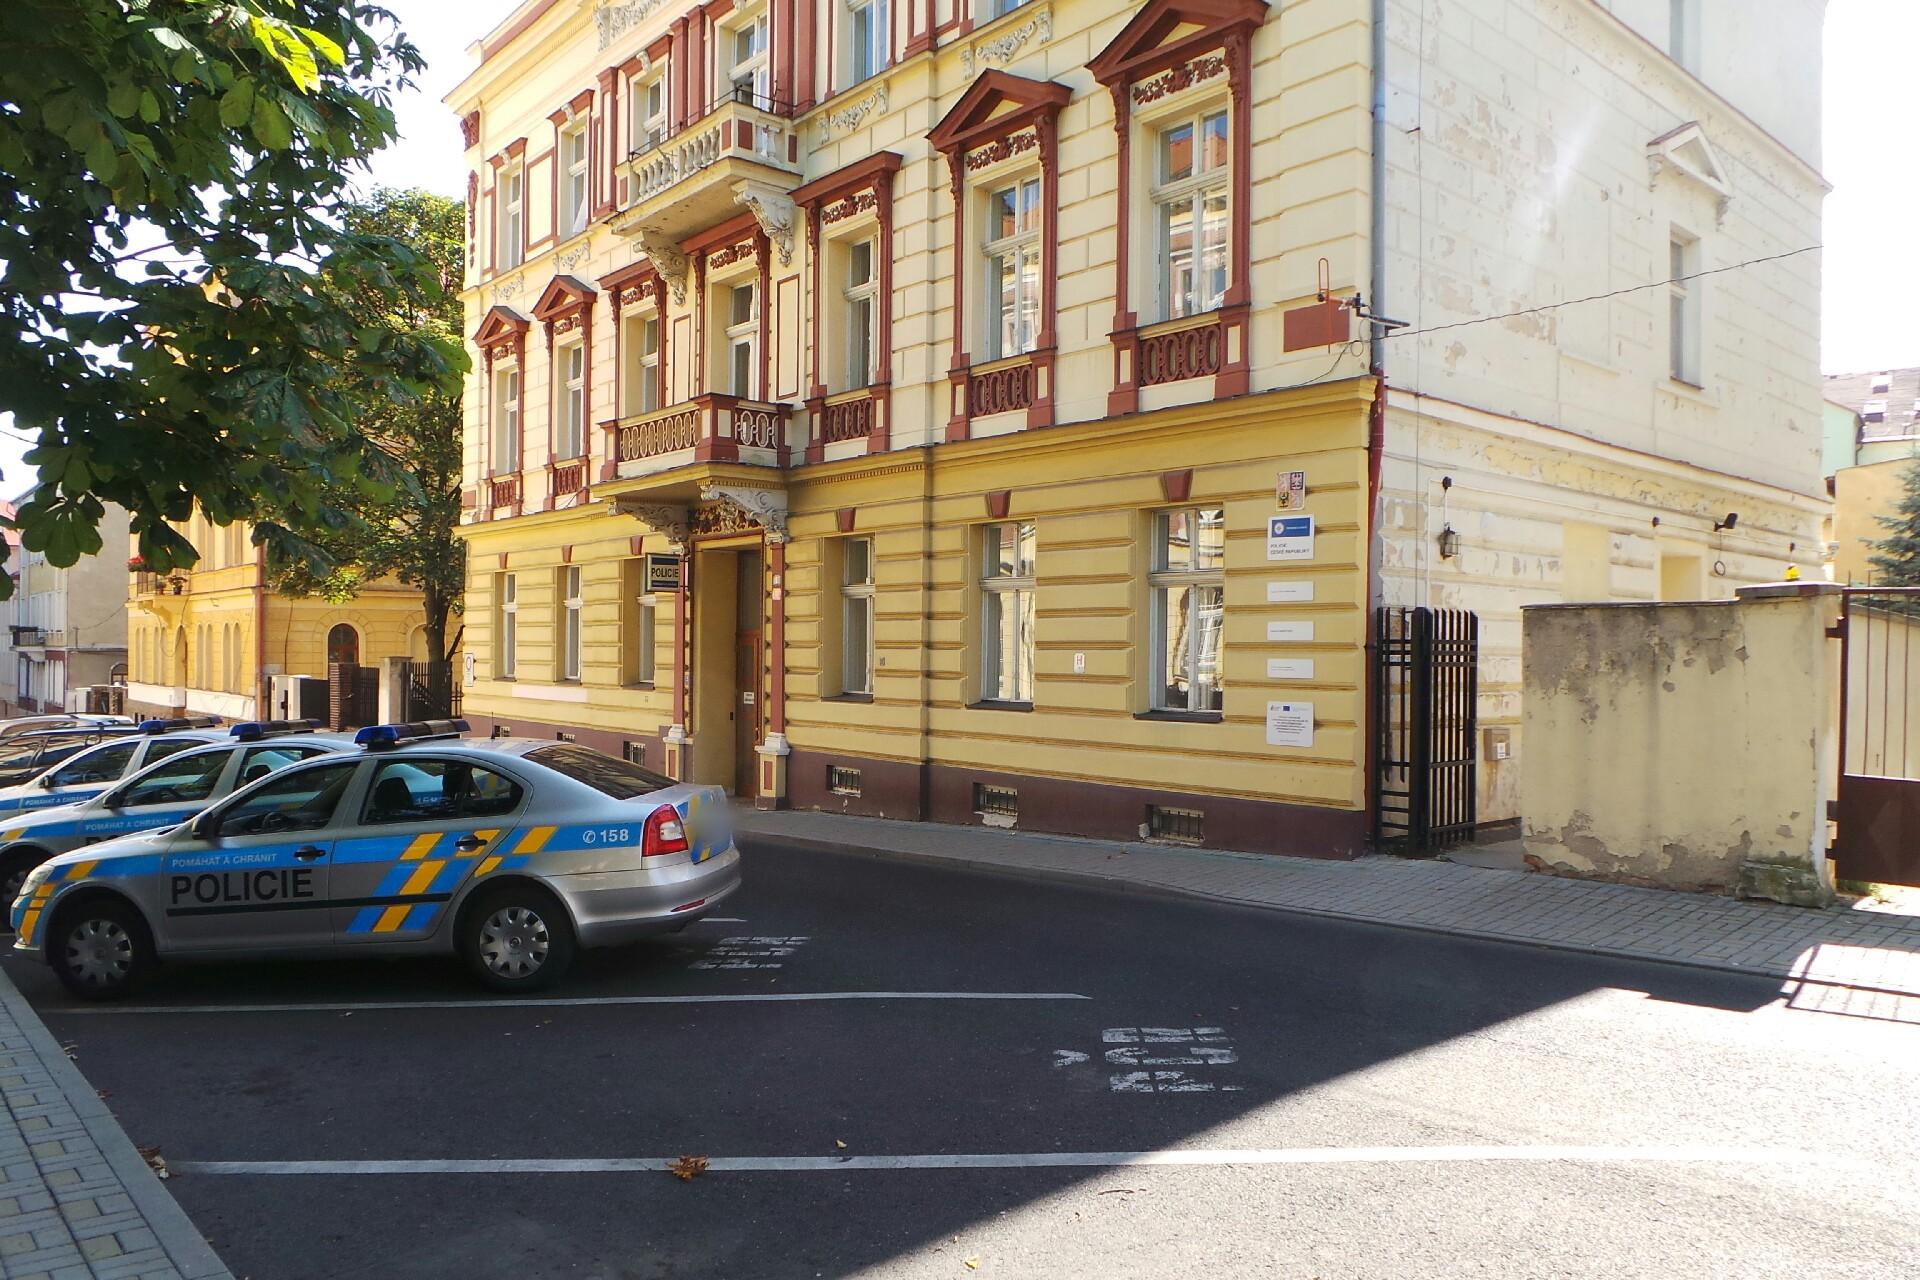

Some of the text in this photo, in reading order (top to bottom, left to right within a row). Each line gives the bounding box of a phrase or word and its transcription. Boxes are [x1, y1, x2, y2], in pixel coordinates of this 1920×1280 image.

[651, 567, 679, 578] POLICIE
[600, 829, 629, 843] 158
[223, 855, 231, 865] A
[171, 868, 314, 905] POLICIE
